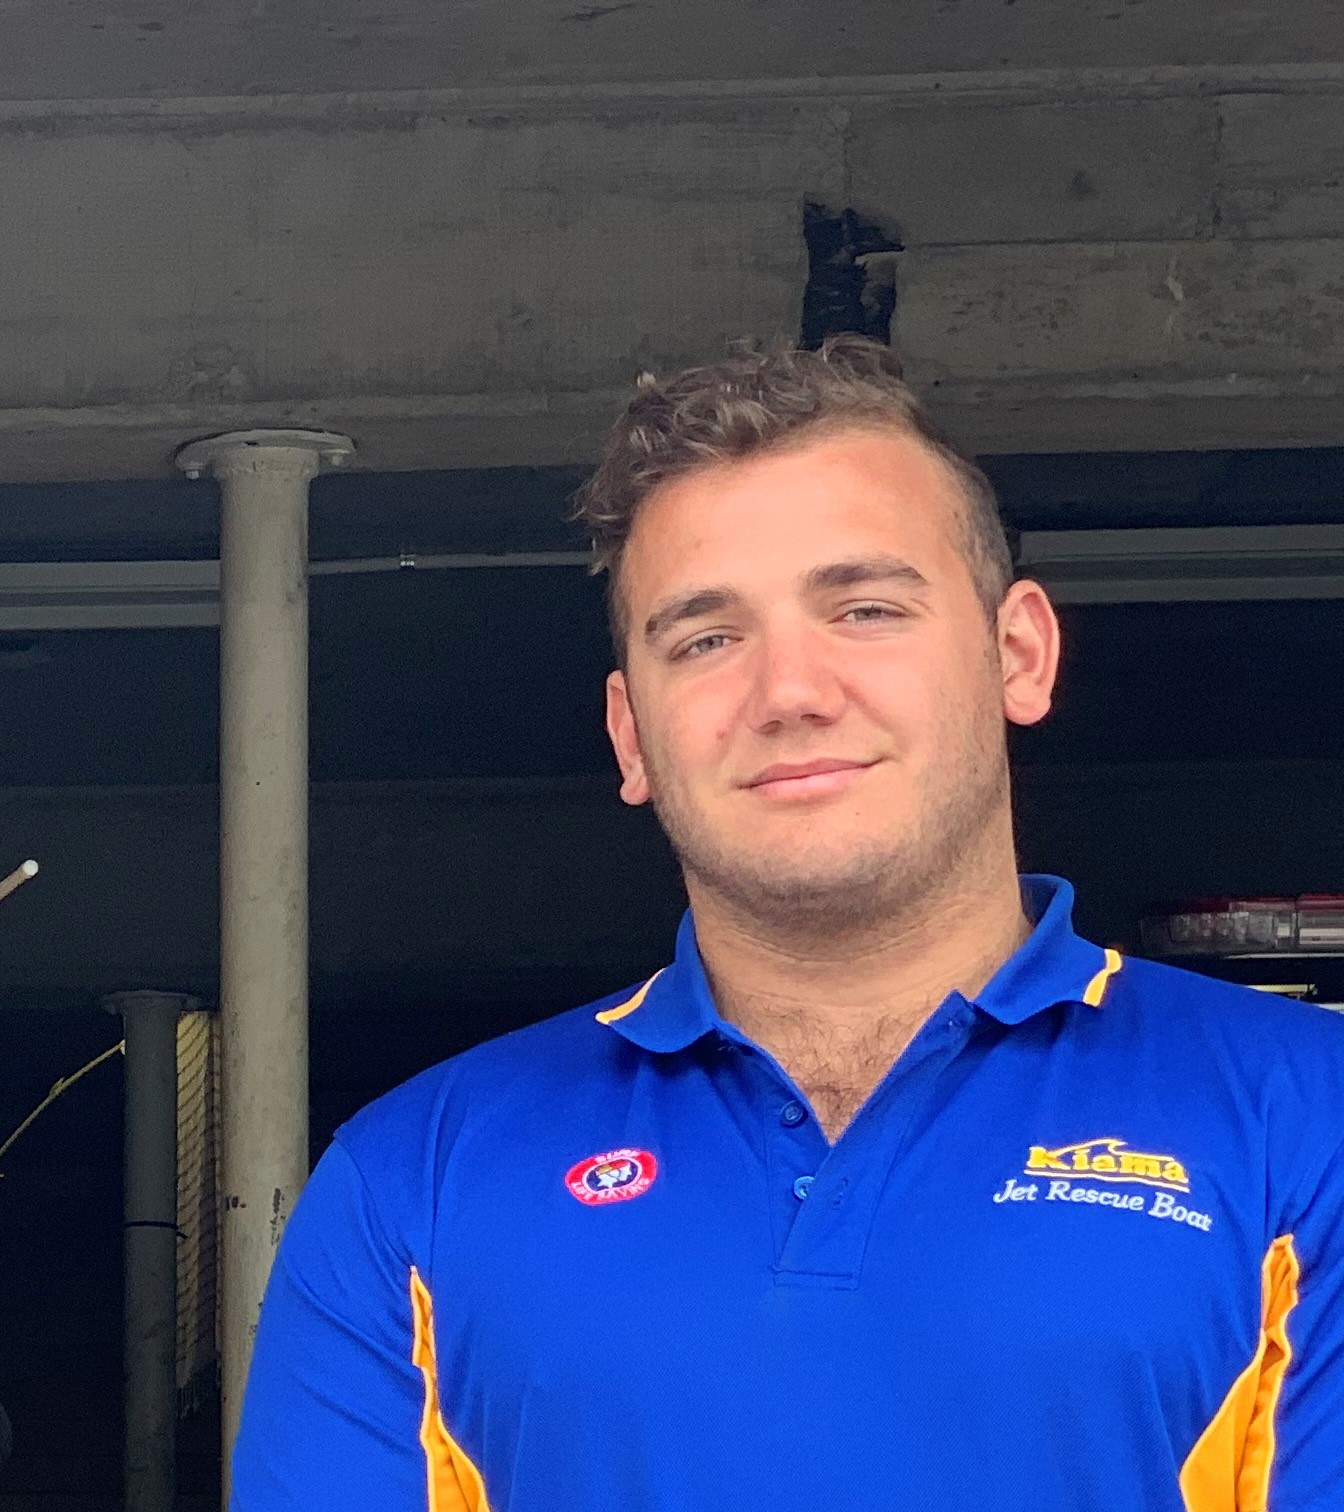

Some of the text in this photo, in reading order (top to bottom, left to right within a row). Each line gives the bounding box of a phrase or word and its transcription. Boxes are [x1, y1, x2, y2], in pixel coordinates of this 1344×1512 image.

[1026, 1145, 1190, 1184] Kiama
[993, 1179, 1214, 1232] Jet Rescue Boat
